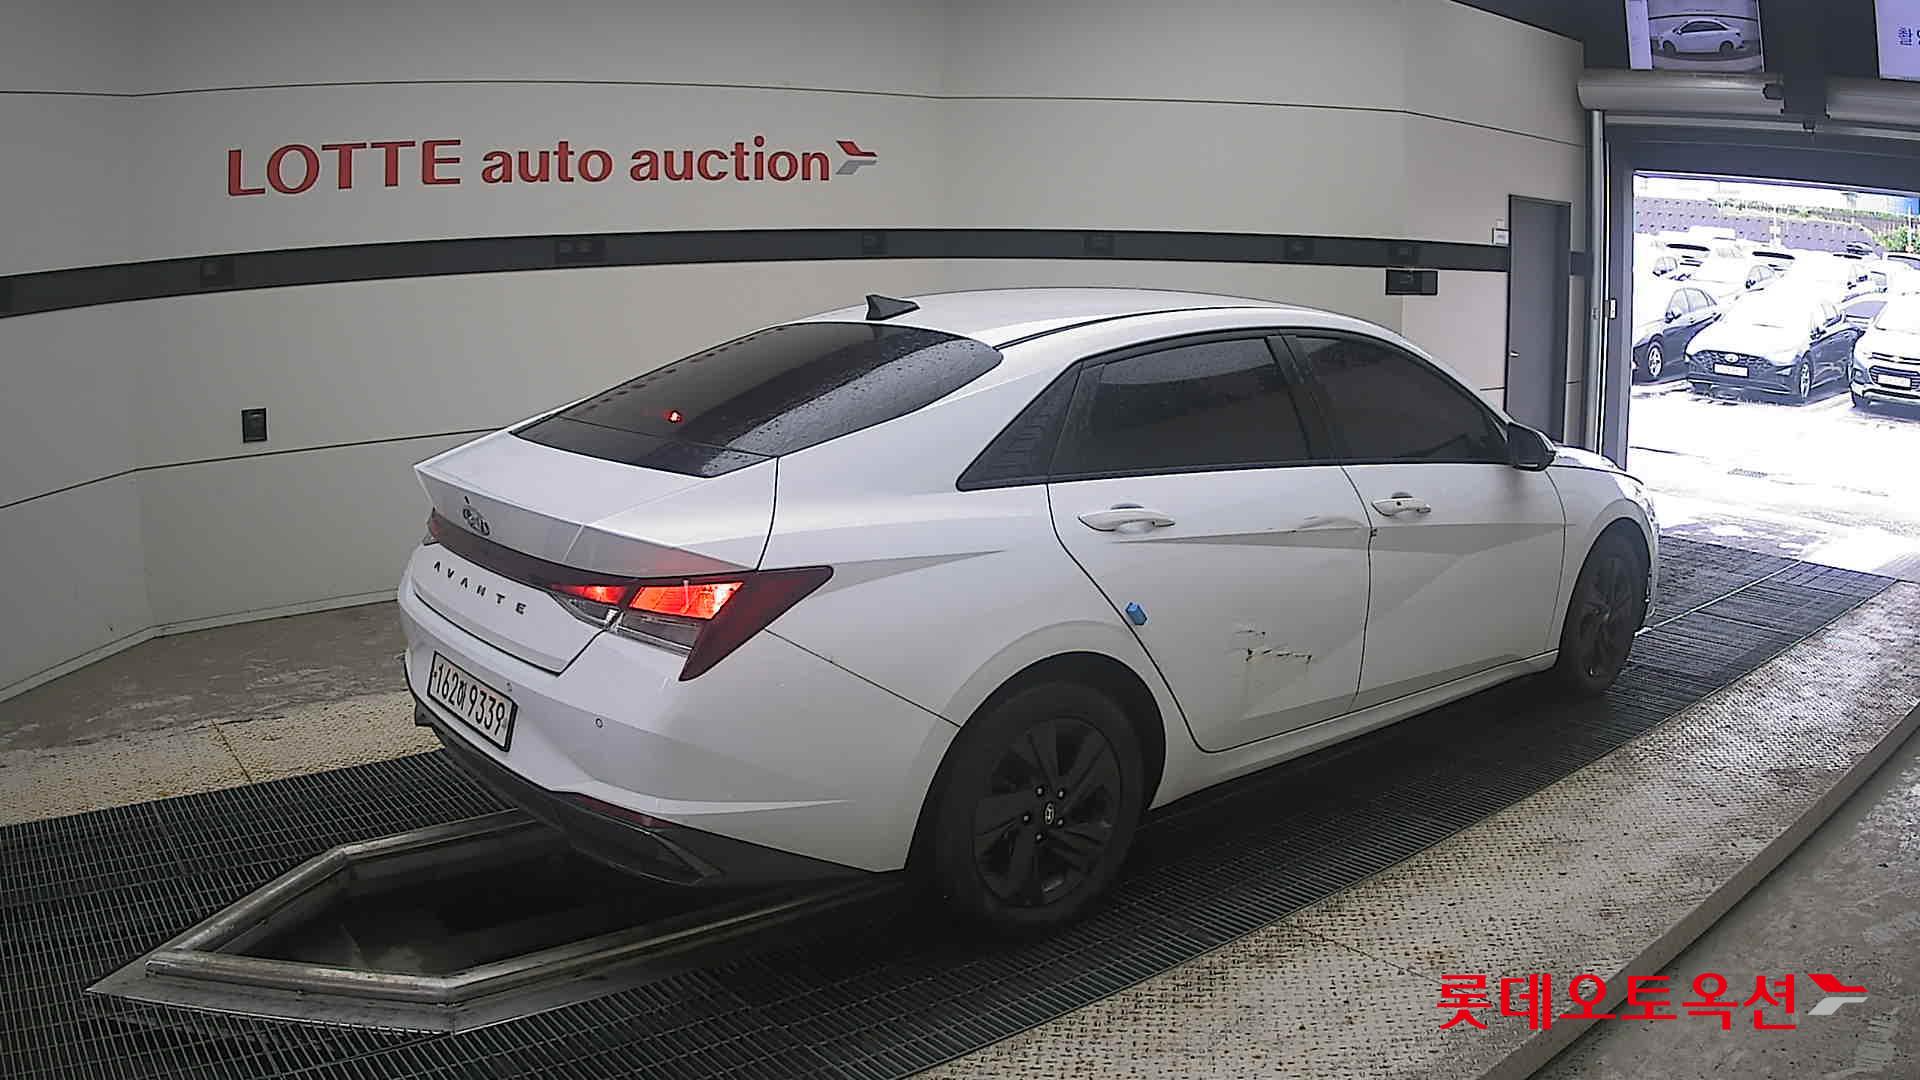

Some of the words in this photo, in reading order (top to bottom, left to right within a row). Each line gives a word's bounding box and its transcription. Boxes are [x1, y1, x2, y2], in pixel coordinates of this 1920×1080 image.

[1898, 26, 1920, 46] 촬
[228, 140, 462, 196] LOTTE
[481, 141, 613, 183] auto
[629, 135, 830, 182] auction
[433, 561, 527, 615] AVANTE
[467, 684, 505, 737] 9339
